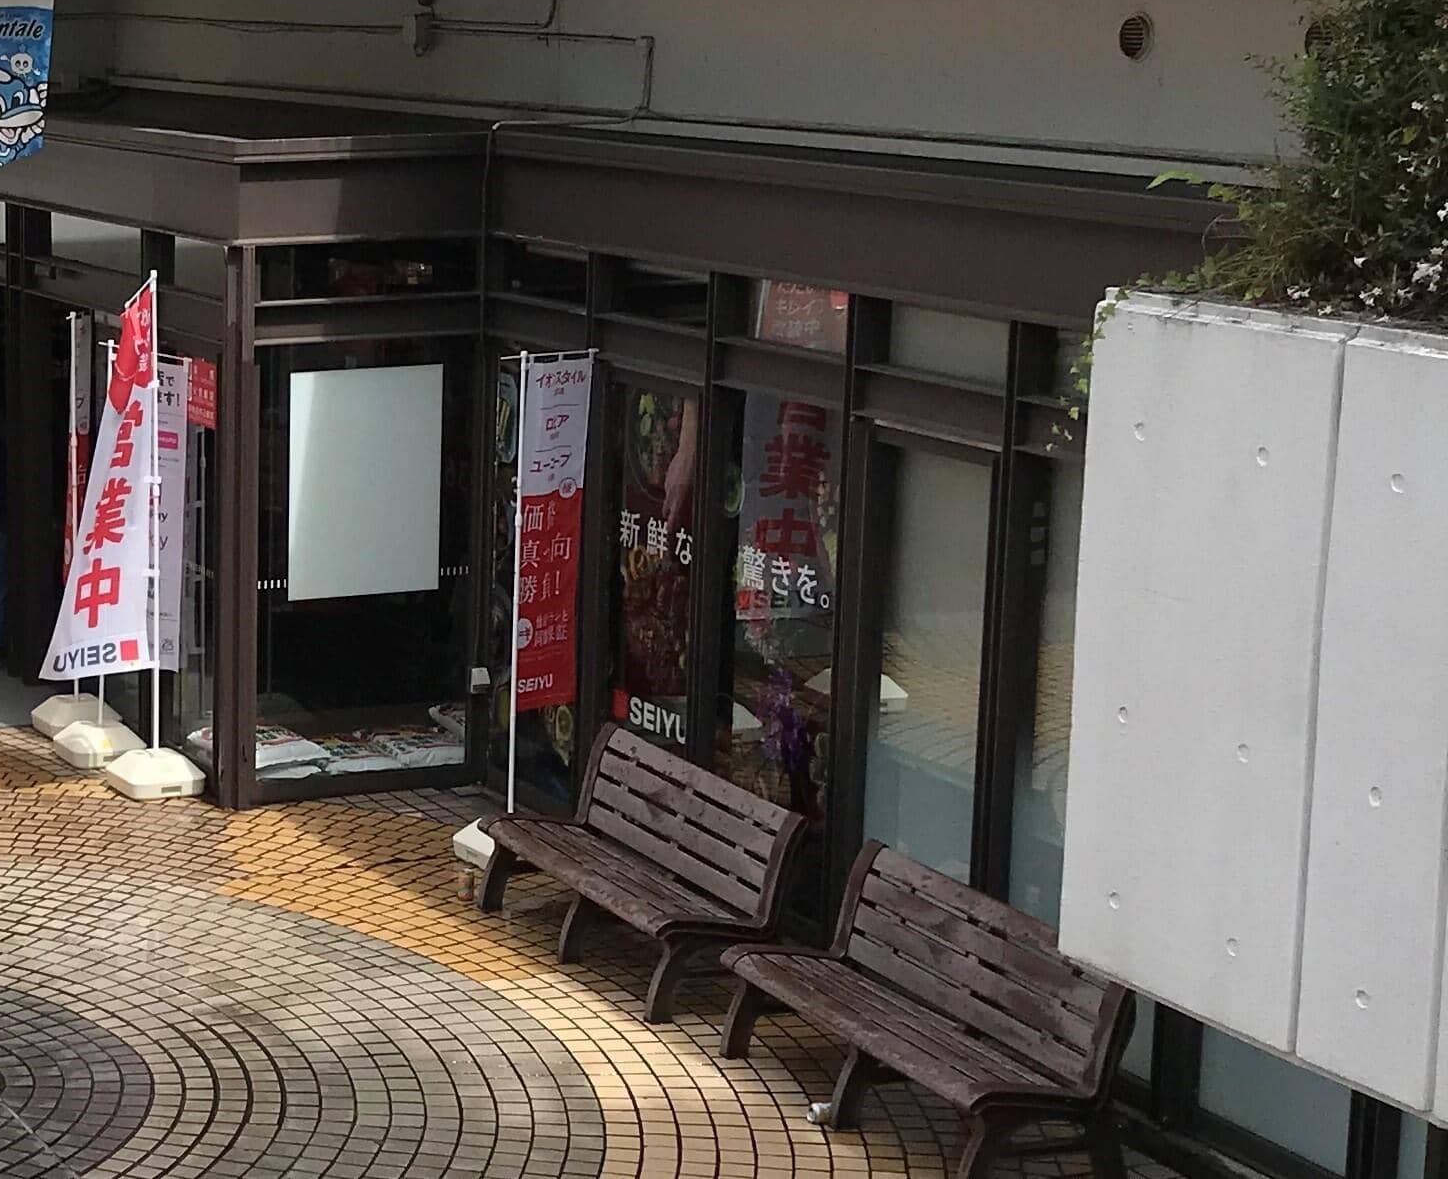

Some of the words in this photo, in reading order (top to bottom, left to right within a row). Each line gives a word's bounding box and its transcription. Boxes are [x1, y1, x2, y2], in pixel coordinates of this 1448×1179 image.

[618, 509, 694, 565] 新鮮な
[741, 545, 830, 609] 驚きを。
[517, 673, 553, 693] SEIYU
[629, 696, 688, 745] SEIYU
